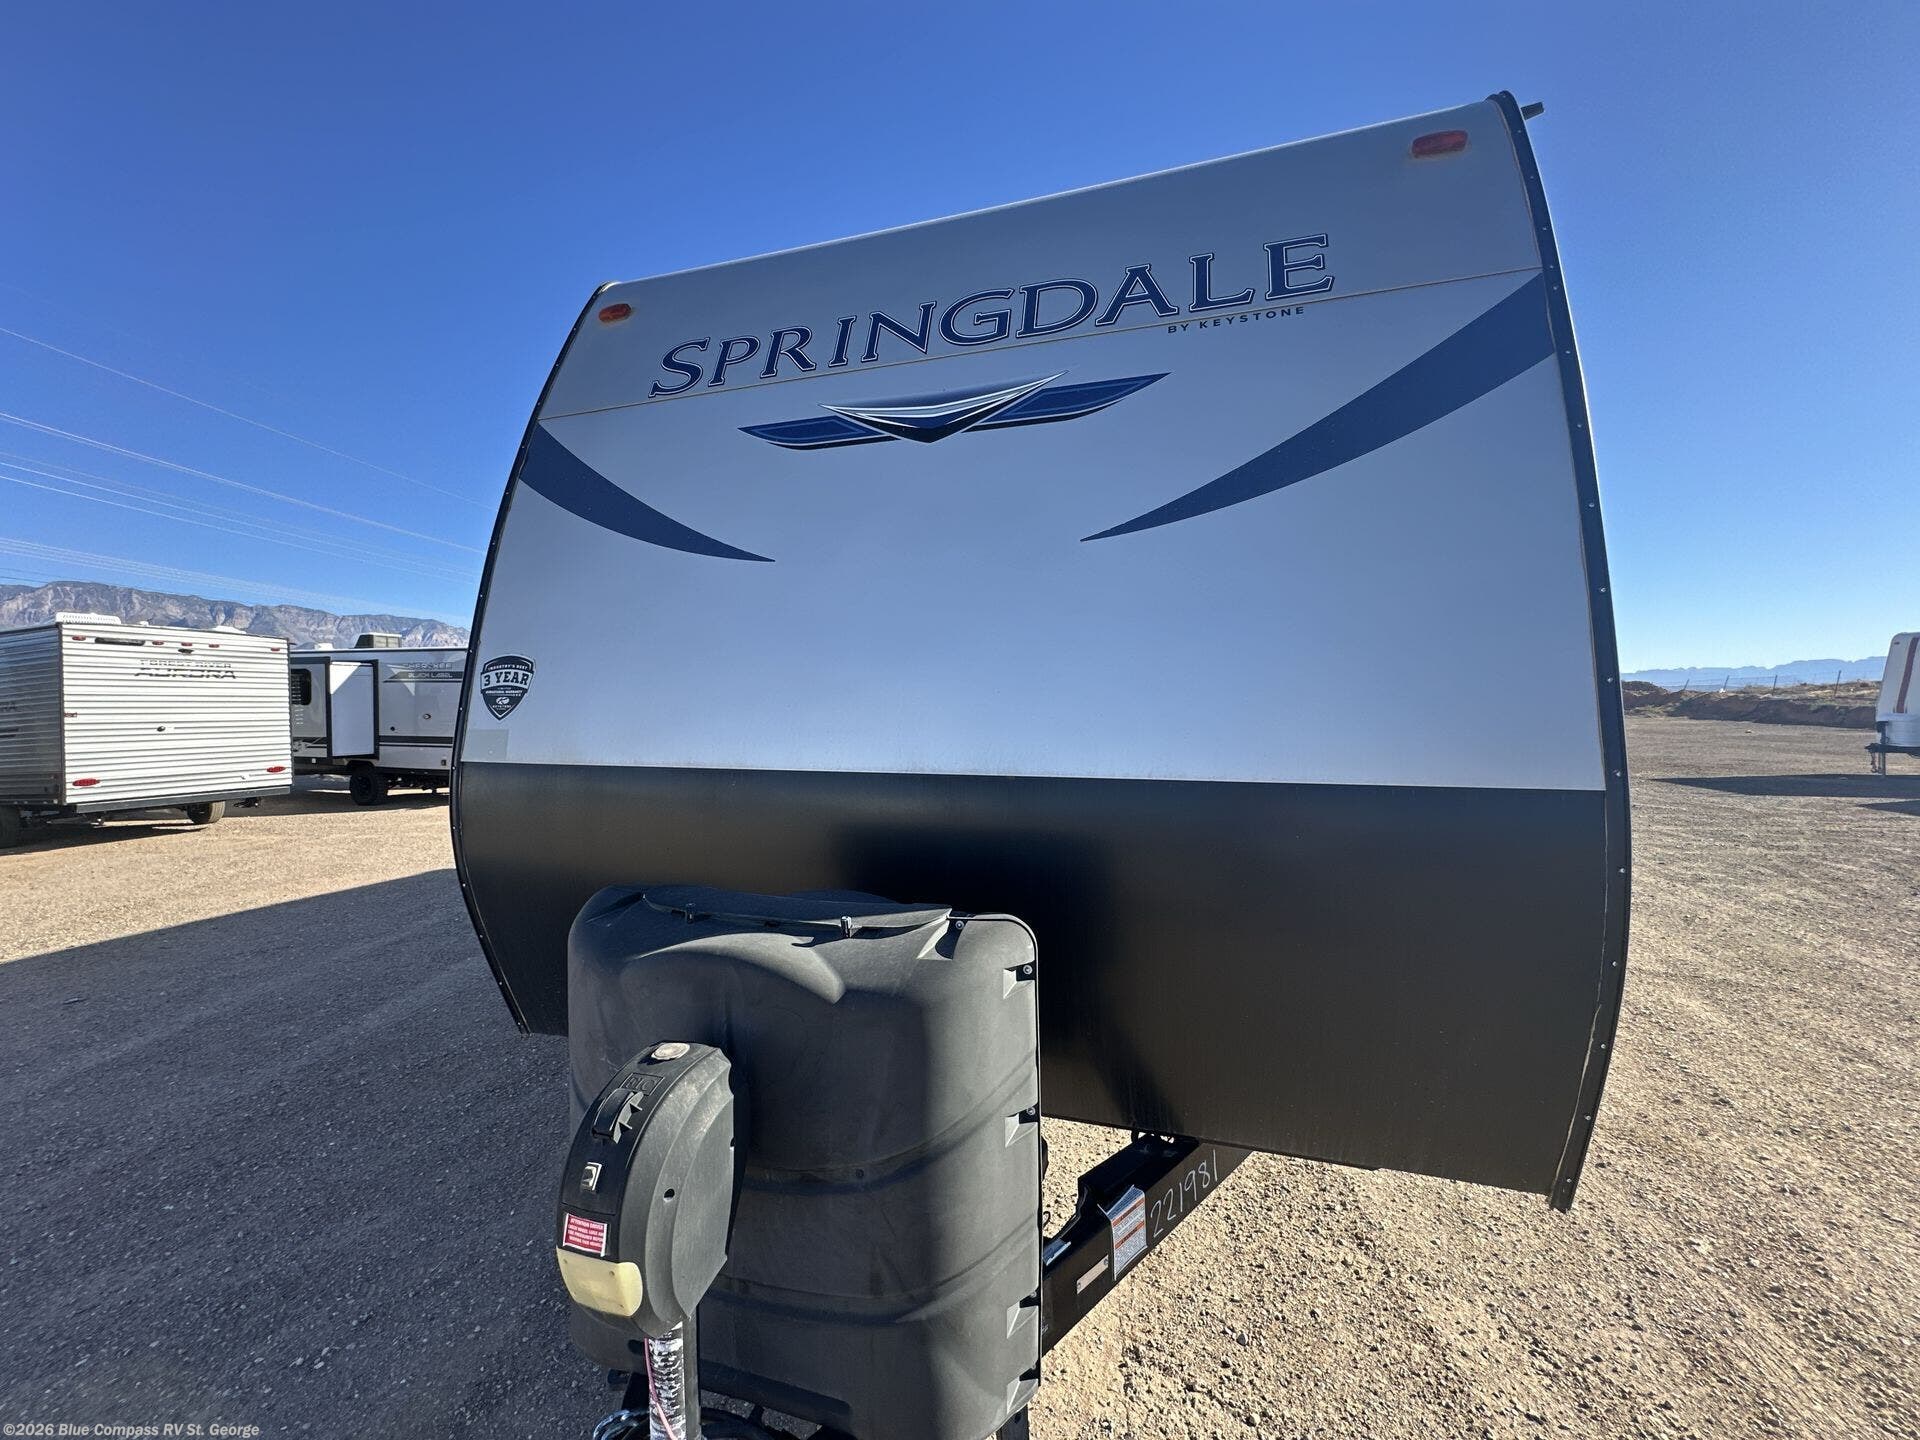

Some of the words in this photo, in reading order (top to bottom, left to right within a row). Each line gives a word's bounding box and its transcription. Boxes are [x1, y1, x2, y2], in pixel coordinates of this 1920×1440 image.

[648, 232, 1335, 398] SPRINGDALE
[1168, 323, 1189, 334] BY
[1199, 306, 1304, 329] KEYSTONE
[134, 667, 236, 679] AURORA
[484, 674, 491, 687] 3
[495, 671, 530, 686] YEAR
[1150, 1149, 1218, 1238] 221981
